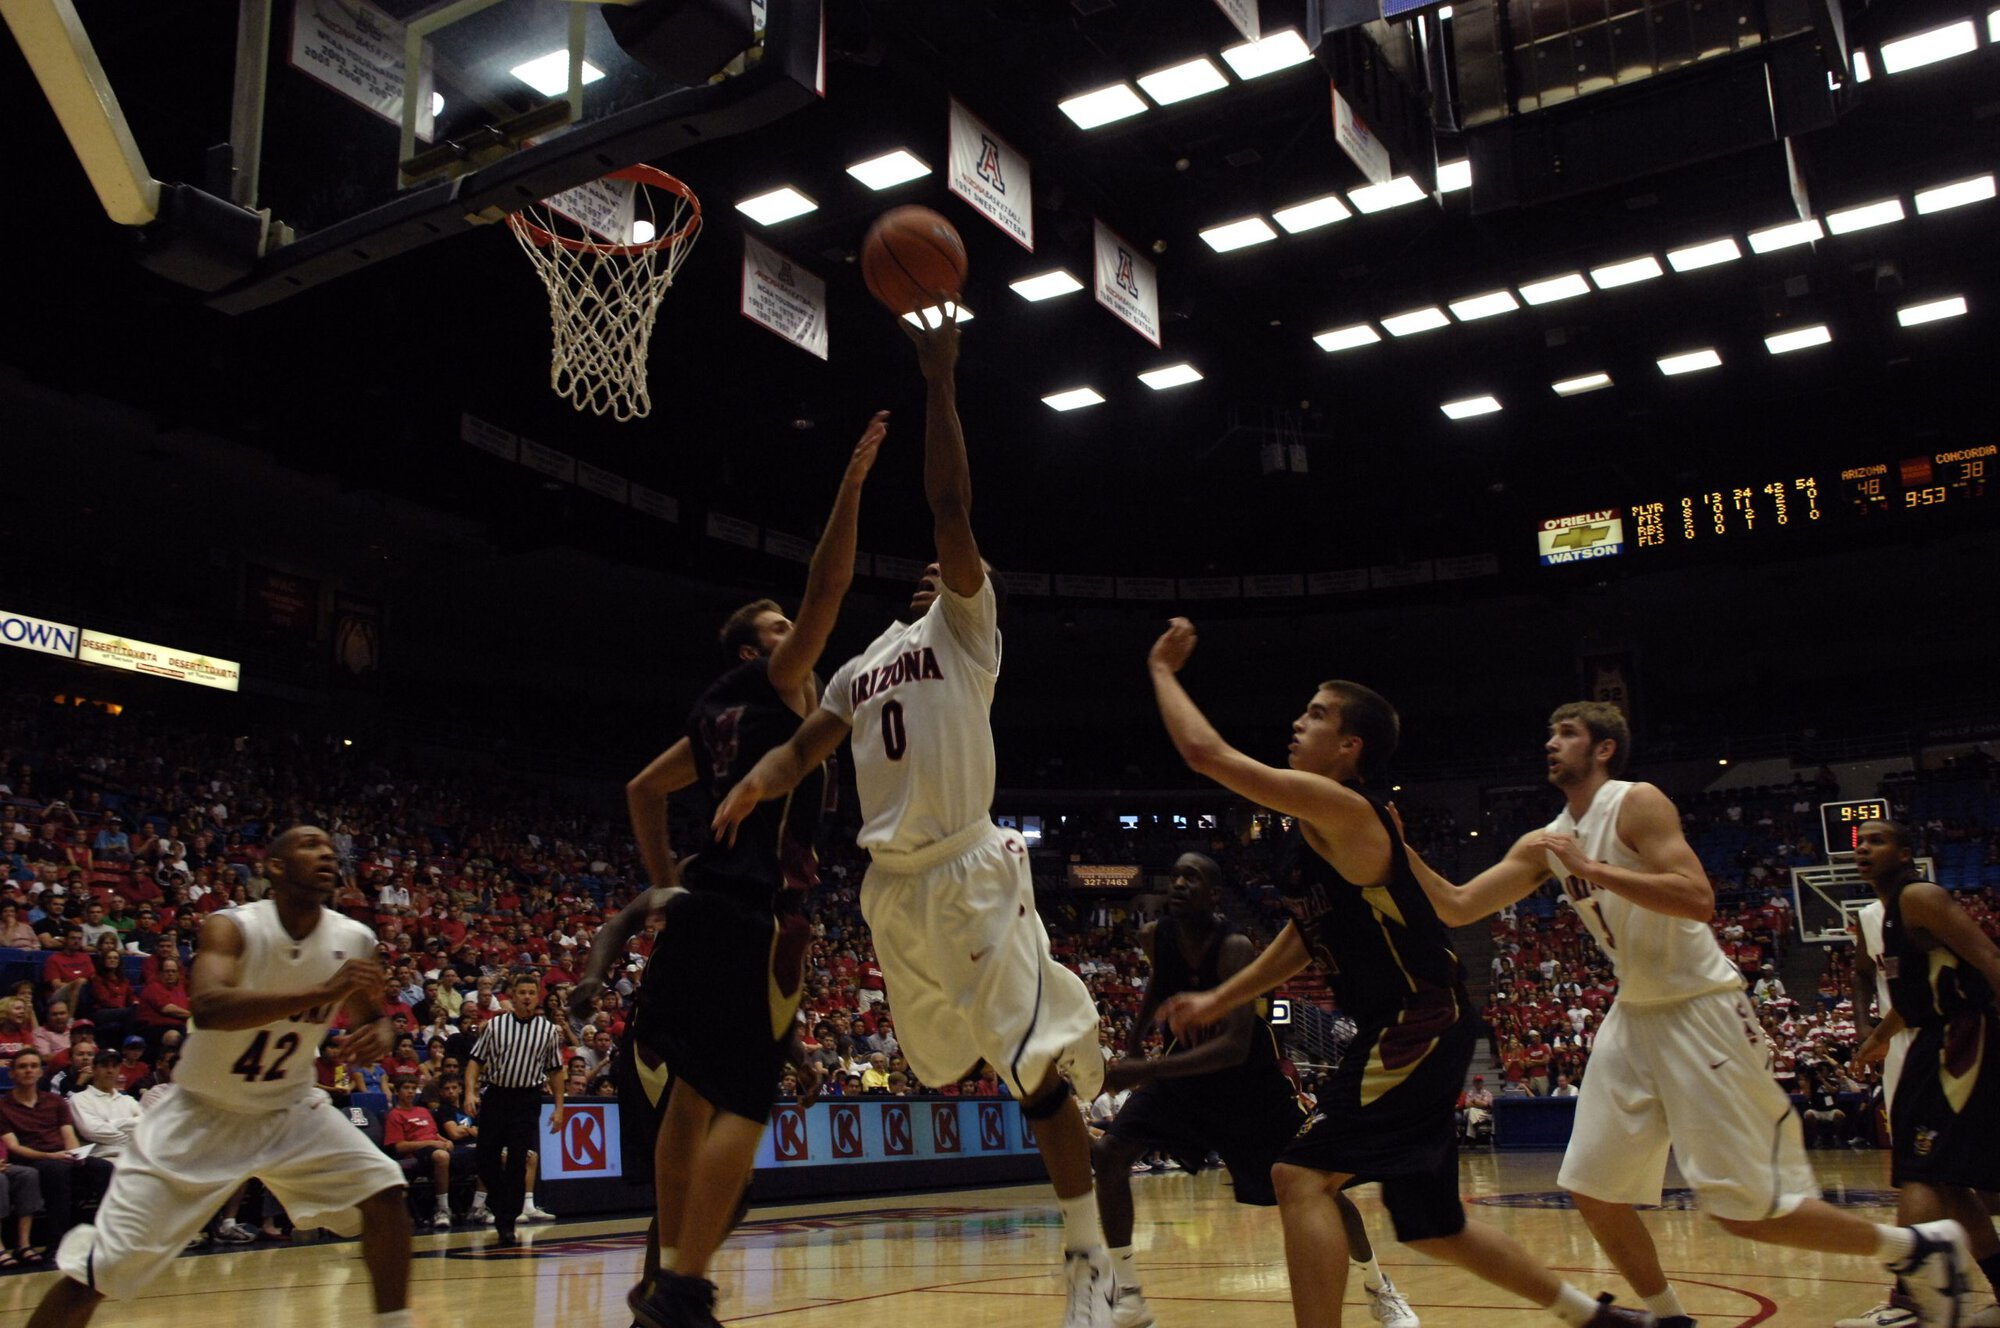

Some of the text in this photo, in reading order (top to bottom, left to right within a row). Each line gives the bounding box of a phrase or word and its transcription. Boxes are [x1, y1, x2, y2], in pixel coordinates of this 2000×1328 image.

[1841, 463, 1888, 481] ARIZONA
[1935, 444, 1999, 465] CONCORDIA
[1857, 460, 1984, 495] 48 38
[1631, 502, 1664, 517] PLYR
[1733, 487, 1753, 500] 34
[1795, 477, 1816, 490] 54
[1905, 486, 1947, 508] 9:53
[1544, 510, 1613, 530] O'RIELLY
[1638, 514, 1661, 526] PTS
[1548, 544, 1618, 565] WATSON
[82, 638, 157, 663] DESERT TOYOTA
[168, 657, 200, 671] DESERT
[205, 664, 237, 679] TOYOTA
[882, 700, 906, 761] 0
[1840, 804, 1881, 822] 9:53
[1083, 878, 1129, 886] 327-7463
[232, 1030, 299, 1082] 42
